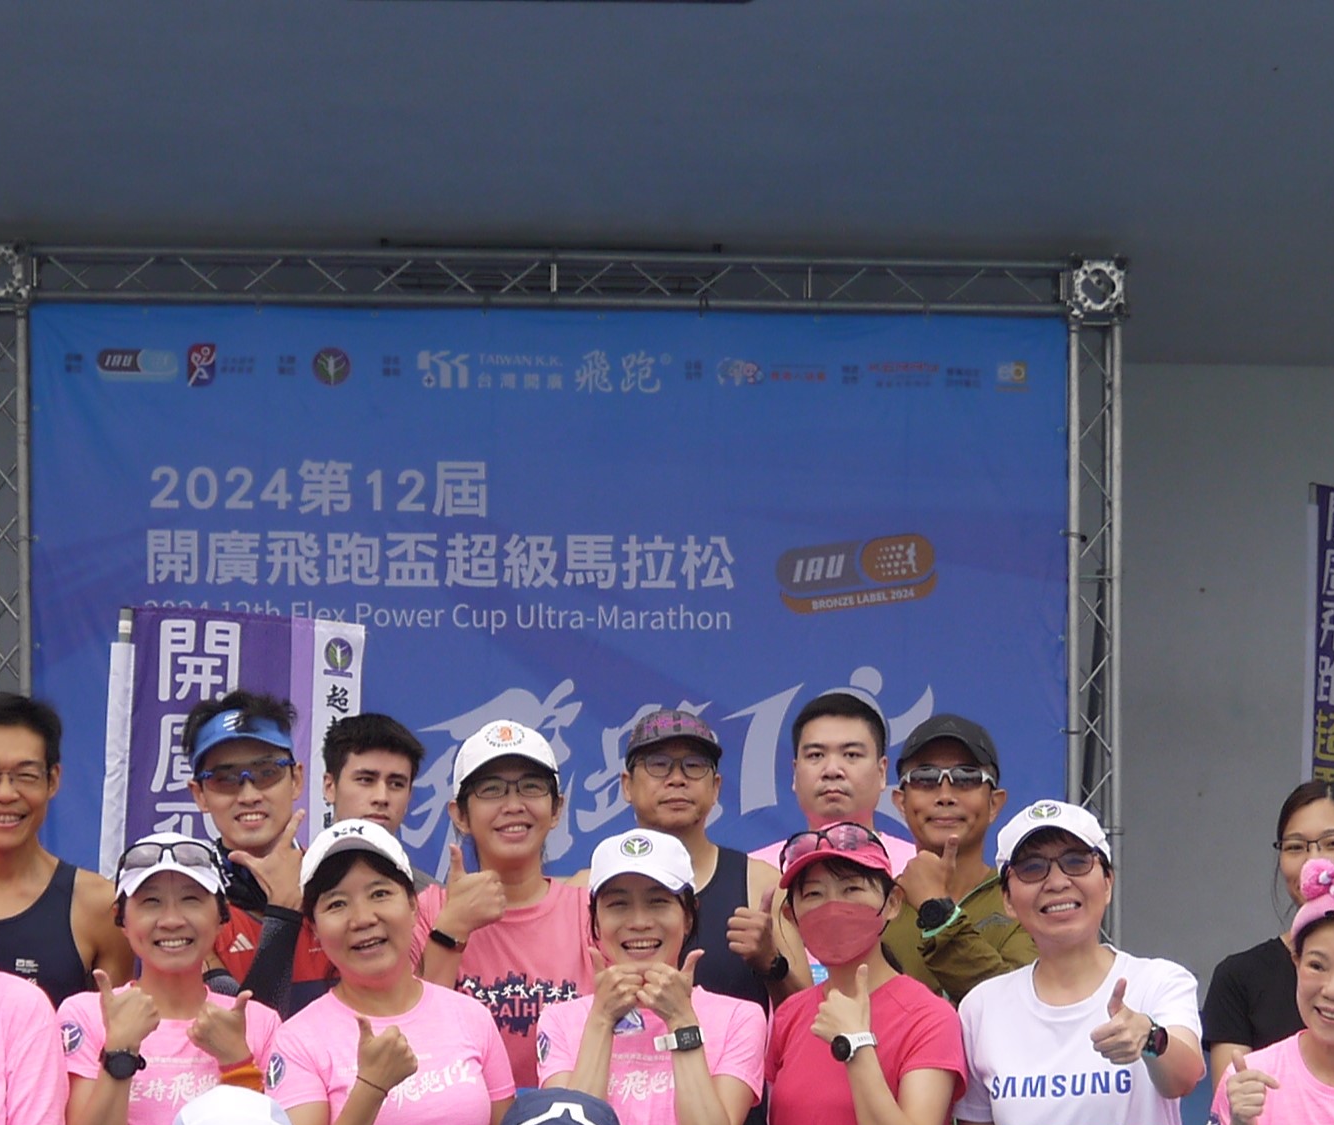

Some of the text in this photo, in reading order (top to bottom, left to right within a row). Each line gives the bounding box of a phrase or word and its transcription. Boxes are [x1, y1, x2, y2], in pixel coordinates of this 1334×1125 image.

[149, 459, 489, 517] 2024第12屆
[145, 530, 736, 592] 開廣飛跑盃超級馬拉松
[792, 553, 846, 583] IAU
[811, 588, 916, 612] BRONZE LABEL 2024
[356, 603, 446, 631] Power
[452, 604, 506, 636] Cup
[515, 602, 733, 632] Ultra-Marathon
[991, 1068, 1133, 1101] SAMSUNG
